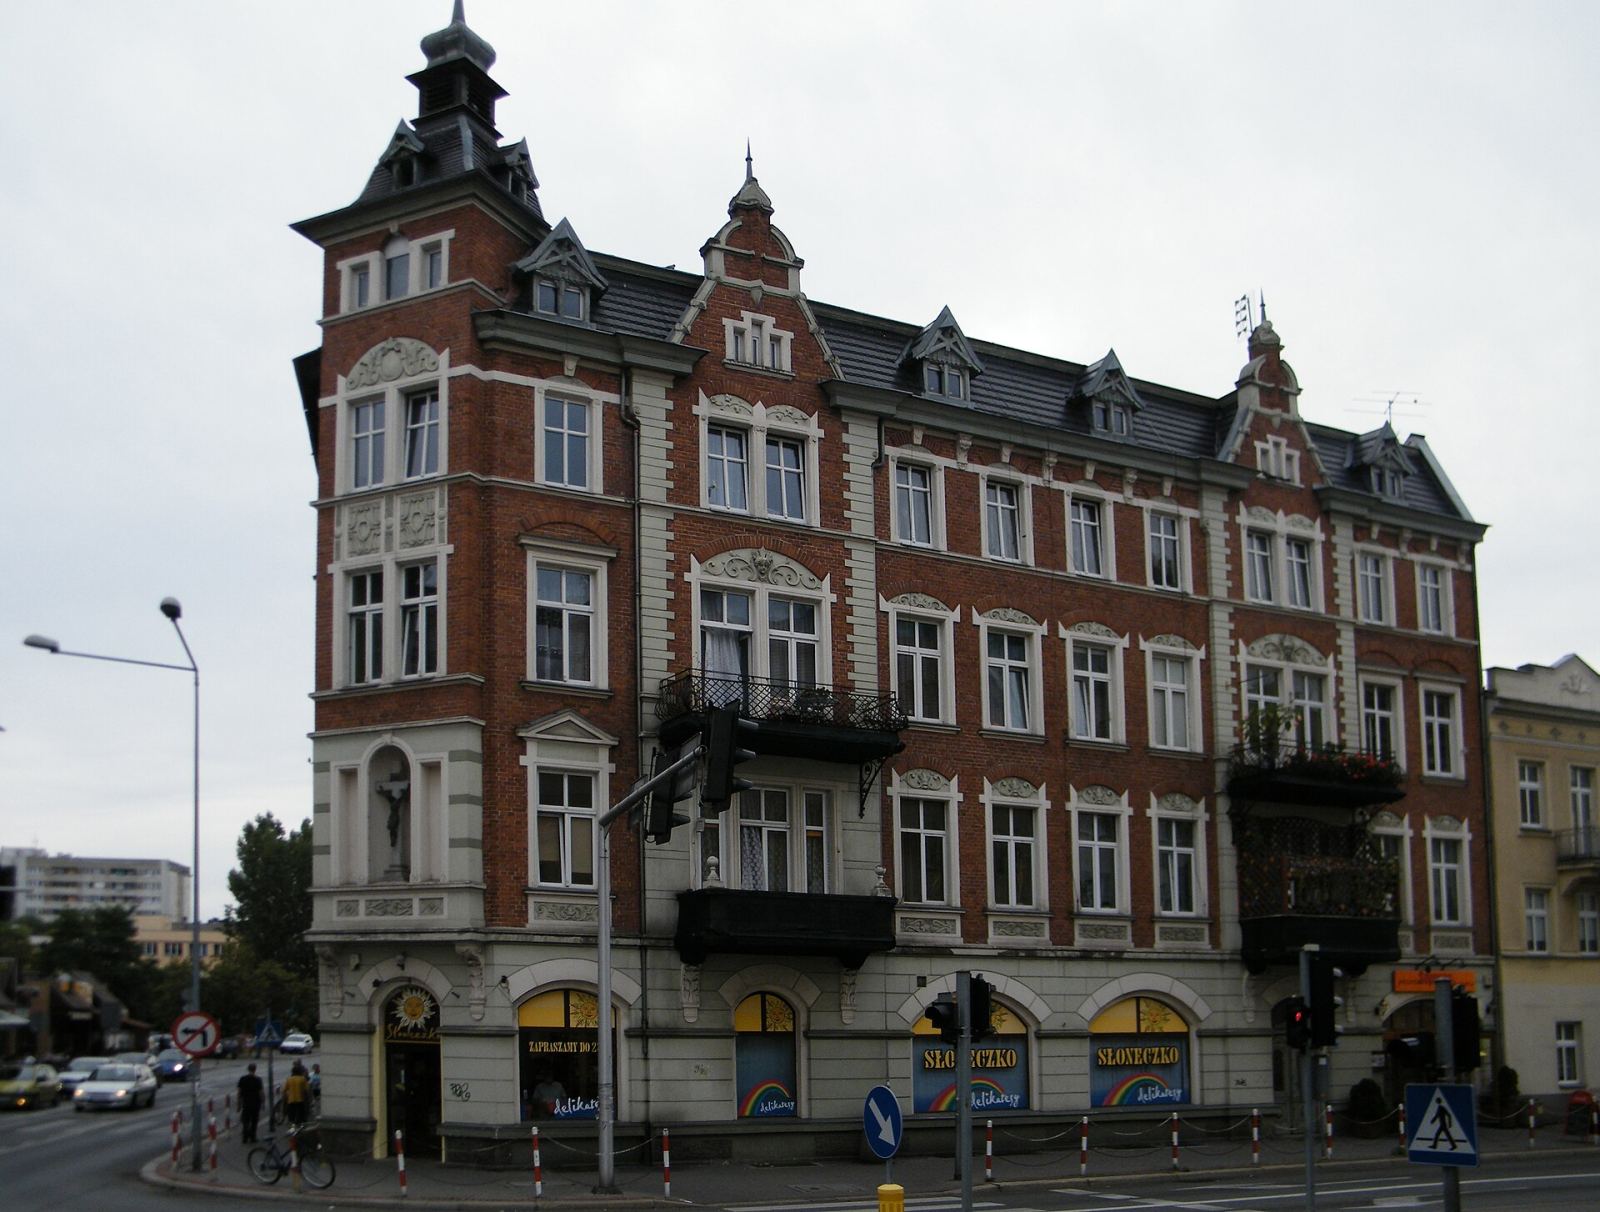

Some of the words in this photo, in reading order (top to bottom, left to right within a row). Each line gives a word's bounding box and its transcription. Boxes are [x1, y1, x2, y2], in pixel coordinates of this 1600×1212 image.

[528, 1040, 578, 1053] ZAPRASZAMY
[579, 1040, 591, 1053] DO
[591, 1040, 599, 1053] 2
[923, 1048, 1018, 1069] SŁOECZKO
[1097, 1047, 1179, 1066] SŁONECZKO
[1137, 1086, 1182, 1103] delikatesy
